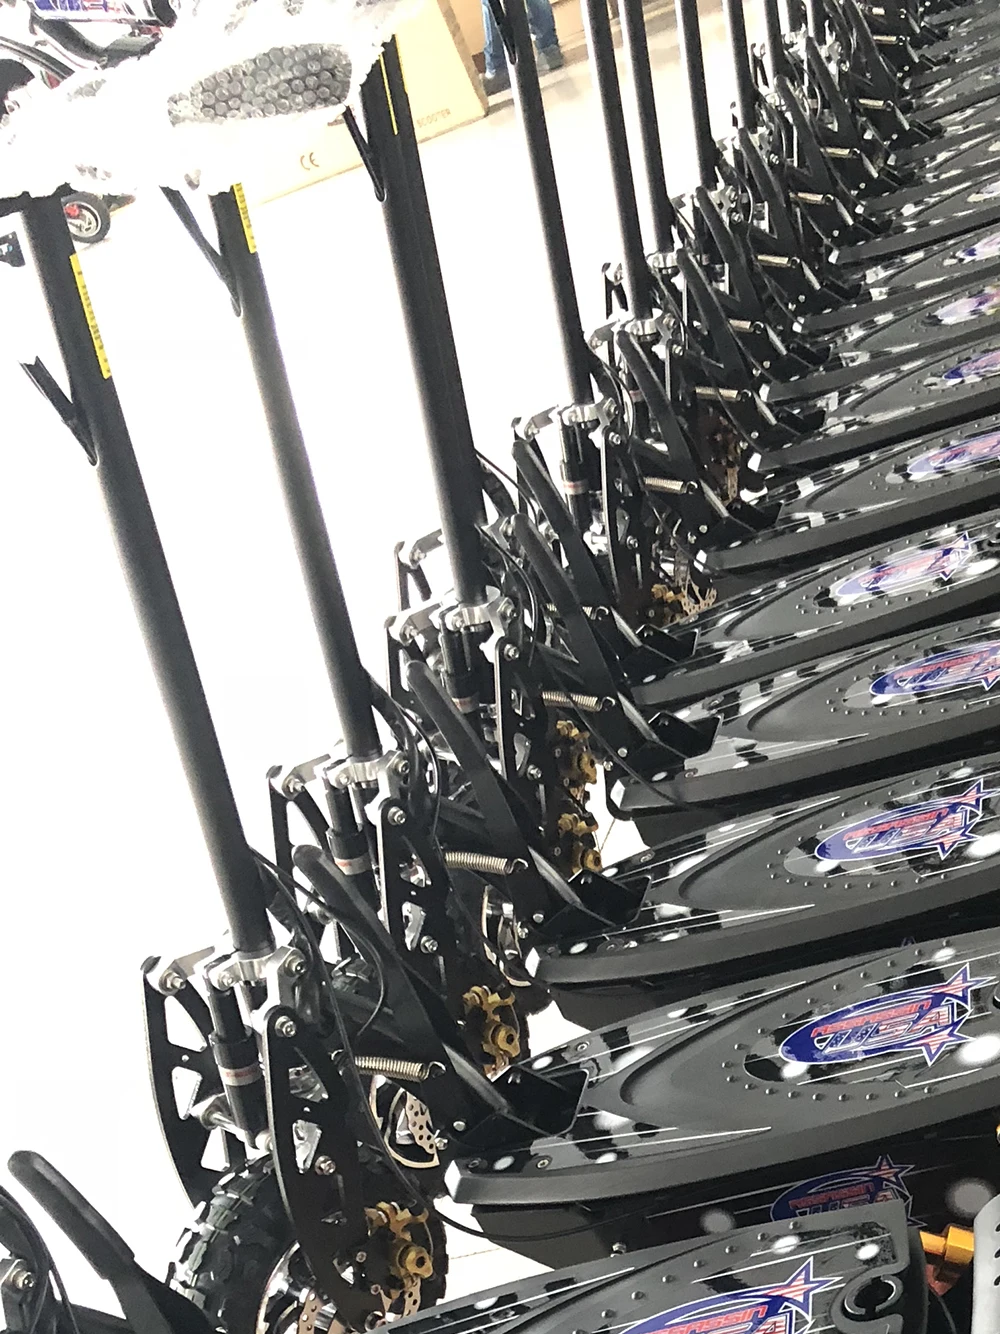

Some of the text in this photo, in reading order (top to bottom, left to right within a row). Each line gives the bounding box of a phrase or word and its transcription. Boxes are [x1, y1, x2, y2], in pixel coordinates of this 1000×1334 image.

[416, 108, 451, 128] SCOOTER
[811, 999, 932, 1037] ASSASSIN
[822, 1006, 951, 1053] USA
